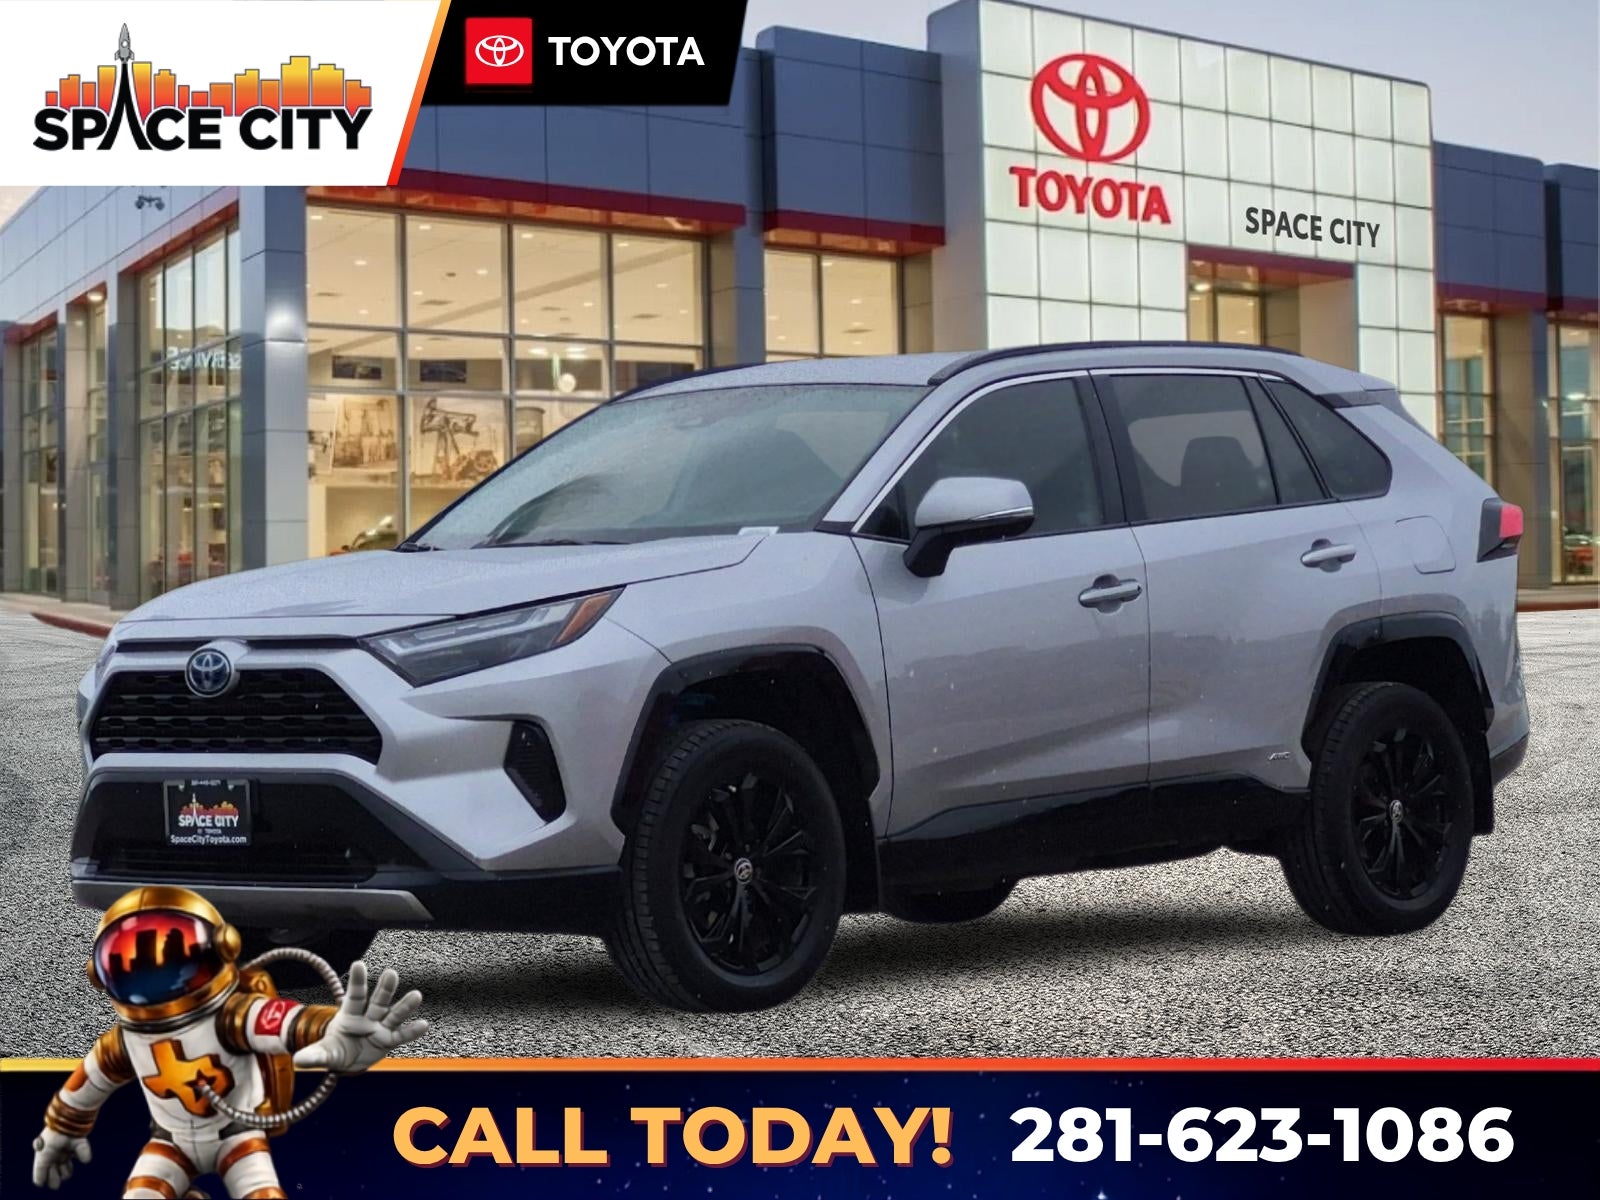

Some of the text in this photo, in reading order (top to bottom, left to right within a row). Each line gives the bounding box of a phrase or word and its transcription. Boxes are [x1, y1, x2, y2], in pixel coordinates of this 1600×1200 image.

[1009, 166, 1171, 224] TOYOTA
[1245, 206, 1381, 248] SPACE CITY
[178, 814, 239, 828] SPACE CITY
[170, 834, 247, 846] SpaceCityToyota.com
